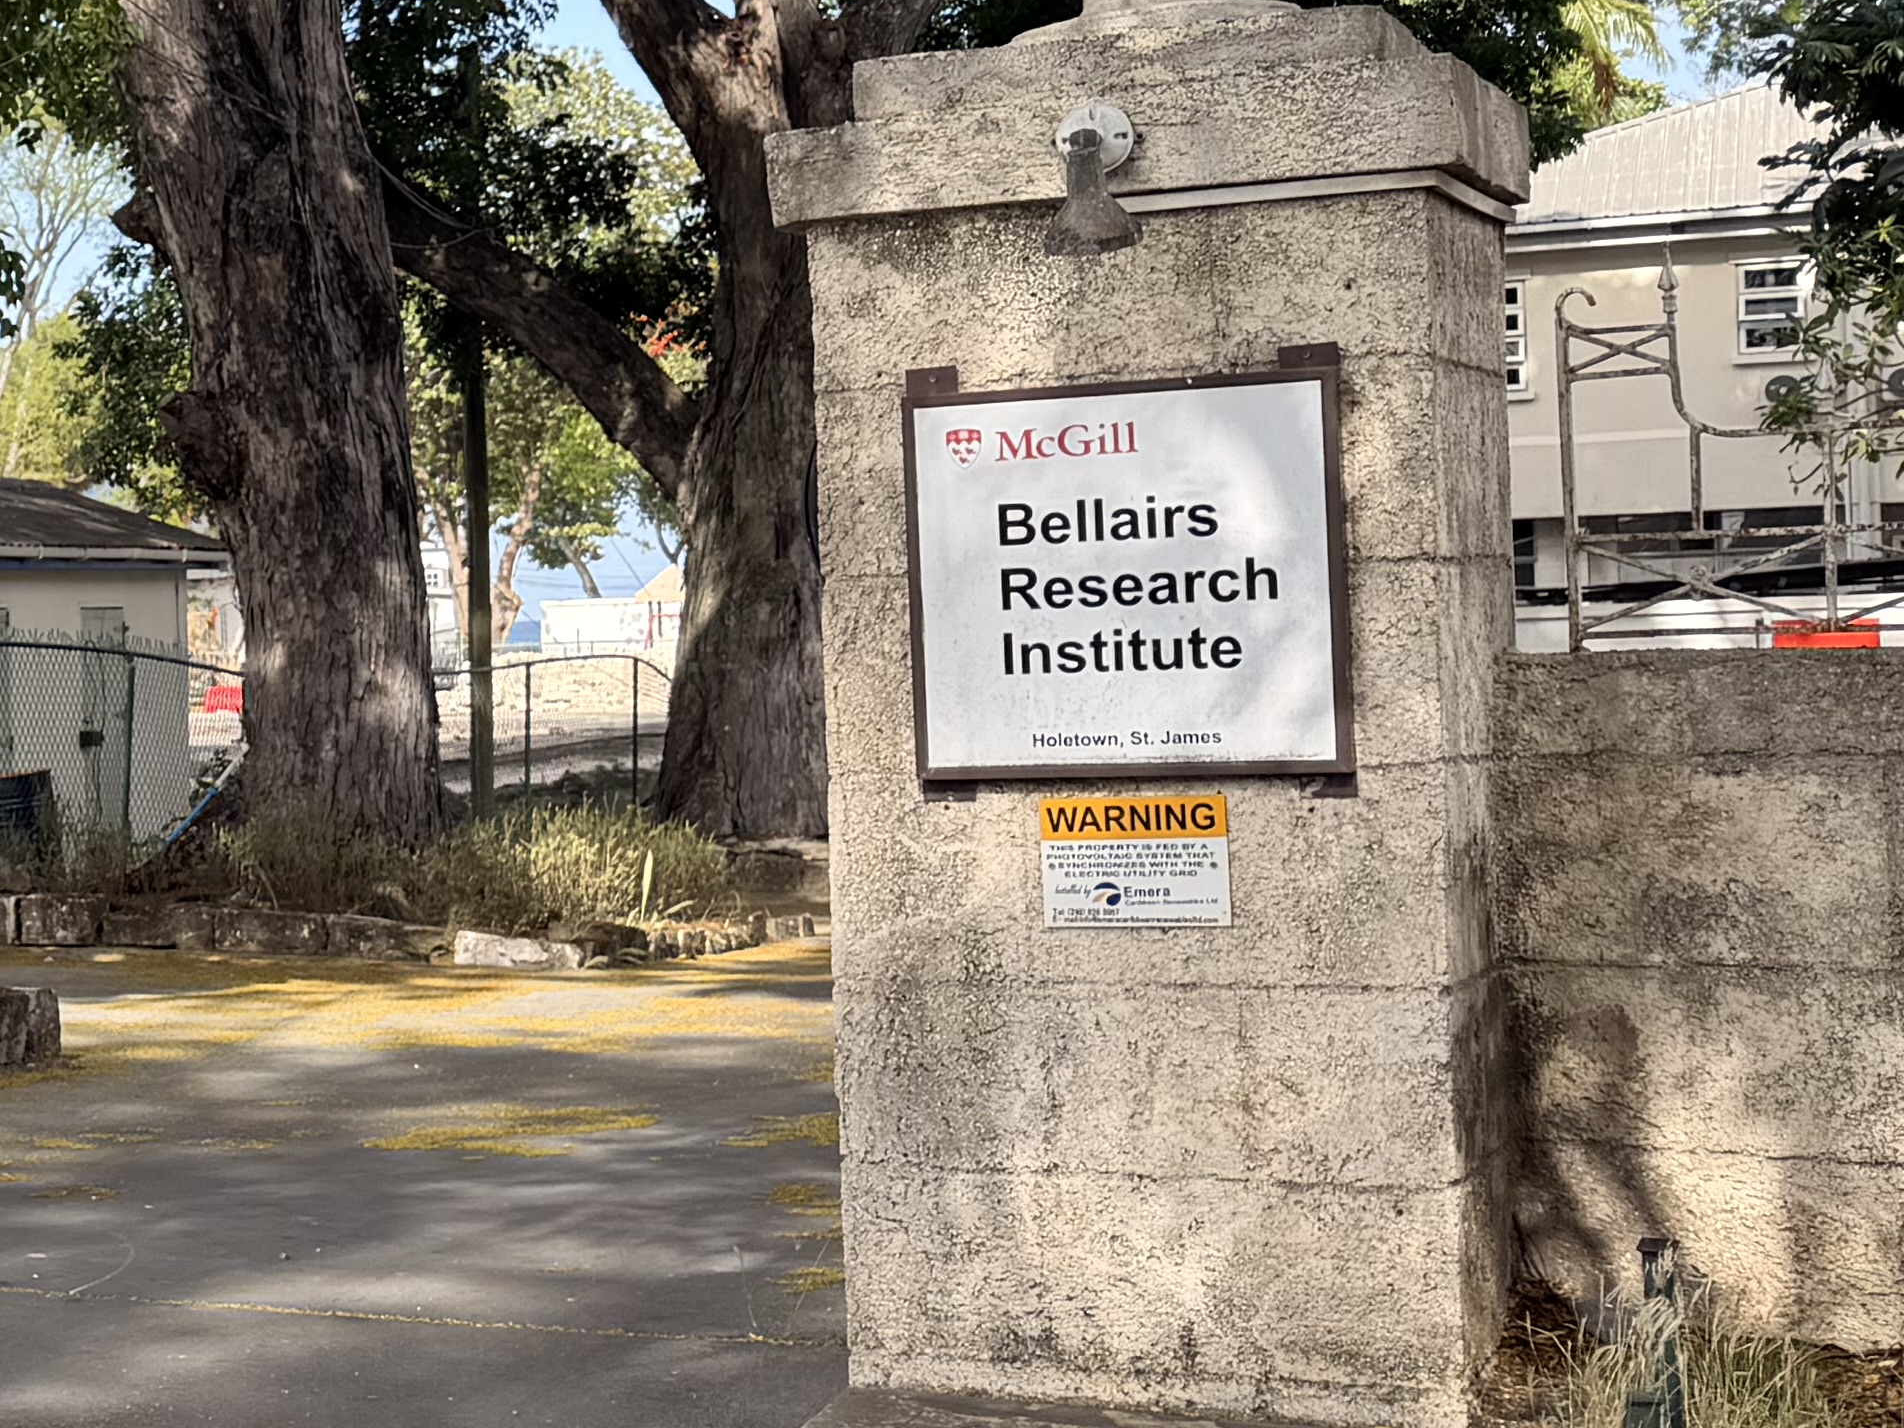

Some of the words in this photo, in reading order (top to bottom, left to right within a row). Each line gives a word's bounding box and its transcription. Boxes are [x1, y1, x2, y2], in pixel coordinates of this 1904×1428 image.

[995, 421, 1139, 462] McGill
[997, 495, 1219, 546] Bellairs
[1000, 556, 1278, 611] Research
[1002, 627, 1243, 675] Institute
[1032, 733, 1124, 748] Holetown,
[1130, 731, 1155, 746] St.
[1160, 730, 1222, 745] James
[1046, 803, 1216, 833] WARNING
